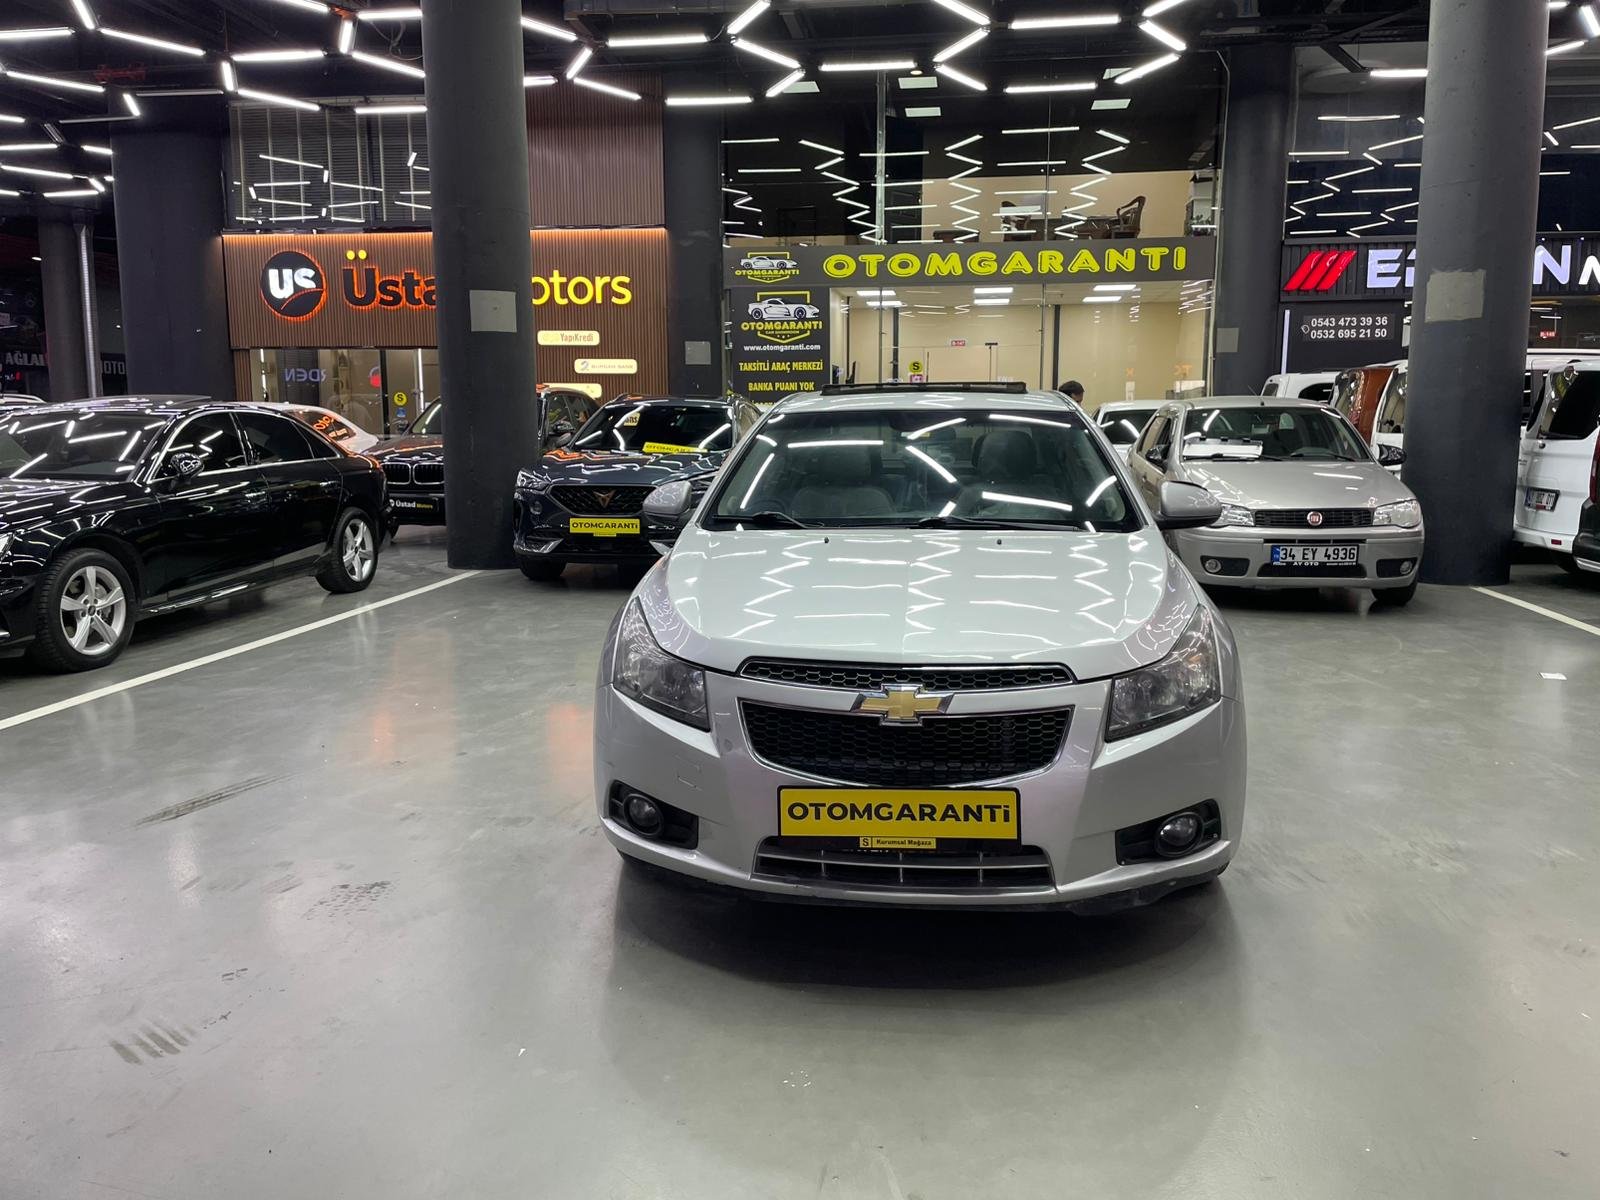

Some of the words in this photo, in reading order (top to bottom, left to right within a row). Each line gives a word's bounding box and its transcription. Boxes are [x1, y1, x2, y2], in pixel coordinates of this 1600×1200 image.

[822, 246, 1187, 278] OTOMGARANTI
[741, 320, 823, 331] OTOMGARANTI
[1311, 317, 1336, 327] 0543
[1338, 317, 1357, 326] 473
[1360, 316, 1373, 326] 39
[1375, 316, 1388, 325] 36
[1310, 330, 1335, 339] 0532
[1338, 329, 1357, 338] 695
[1359, 329, 1371, 338] 21
[1374, 328, 1387, 338] 50
[743, 343, 821, 352] www.otomgaranti.com
[771, 361, 791, 373] ARAÇ
[792, 359, 824, 371] MERKEZİ
[748, 382, 773, 391] BANKA
[774, 382, 798, 391] PUANI
[799, 381, 815, 391] YOK
[1280, 547, 1296, 560] 34
[1302, 547, 1318, 560] EY
[1324, 547, 1356, 560] 4936
